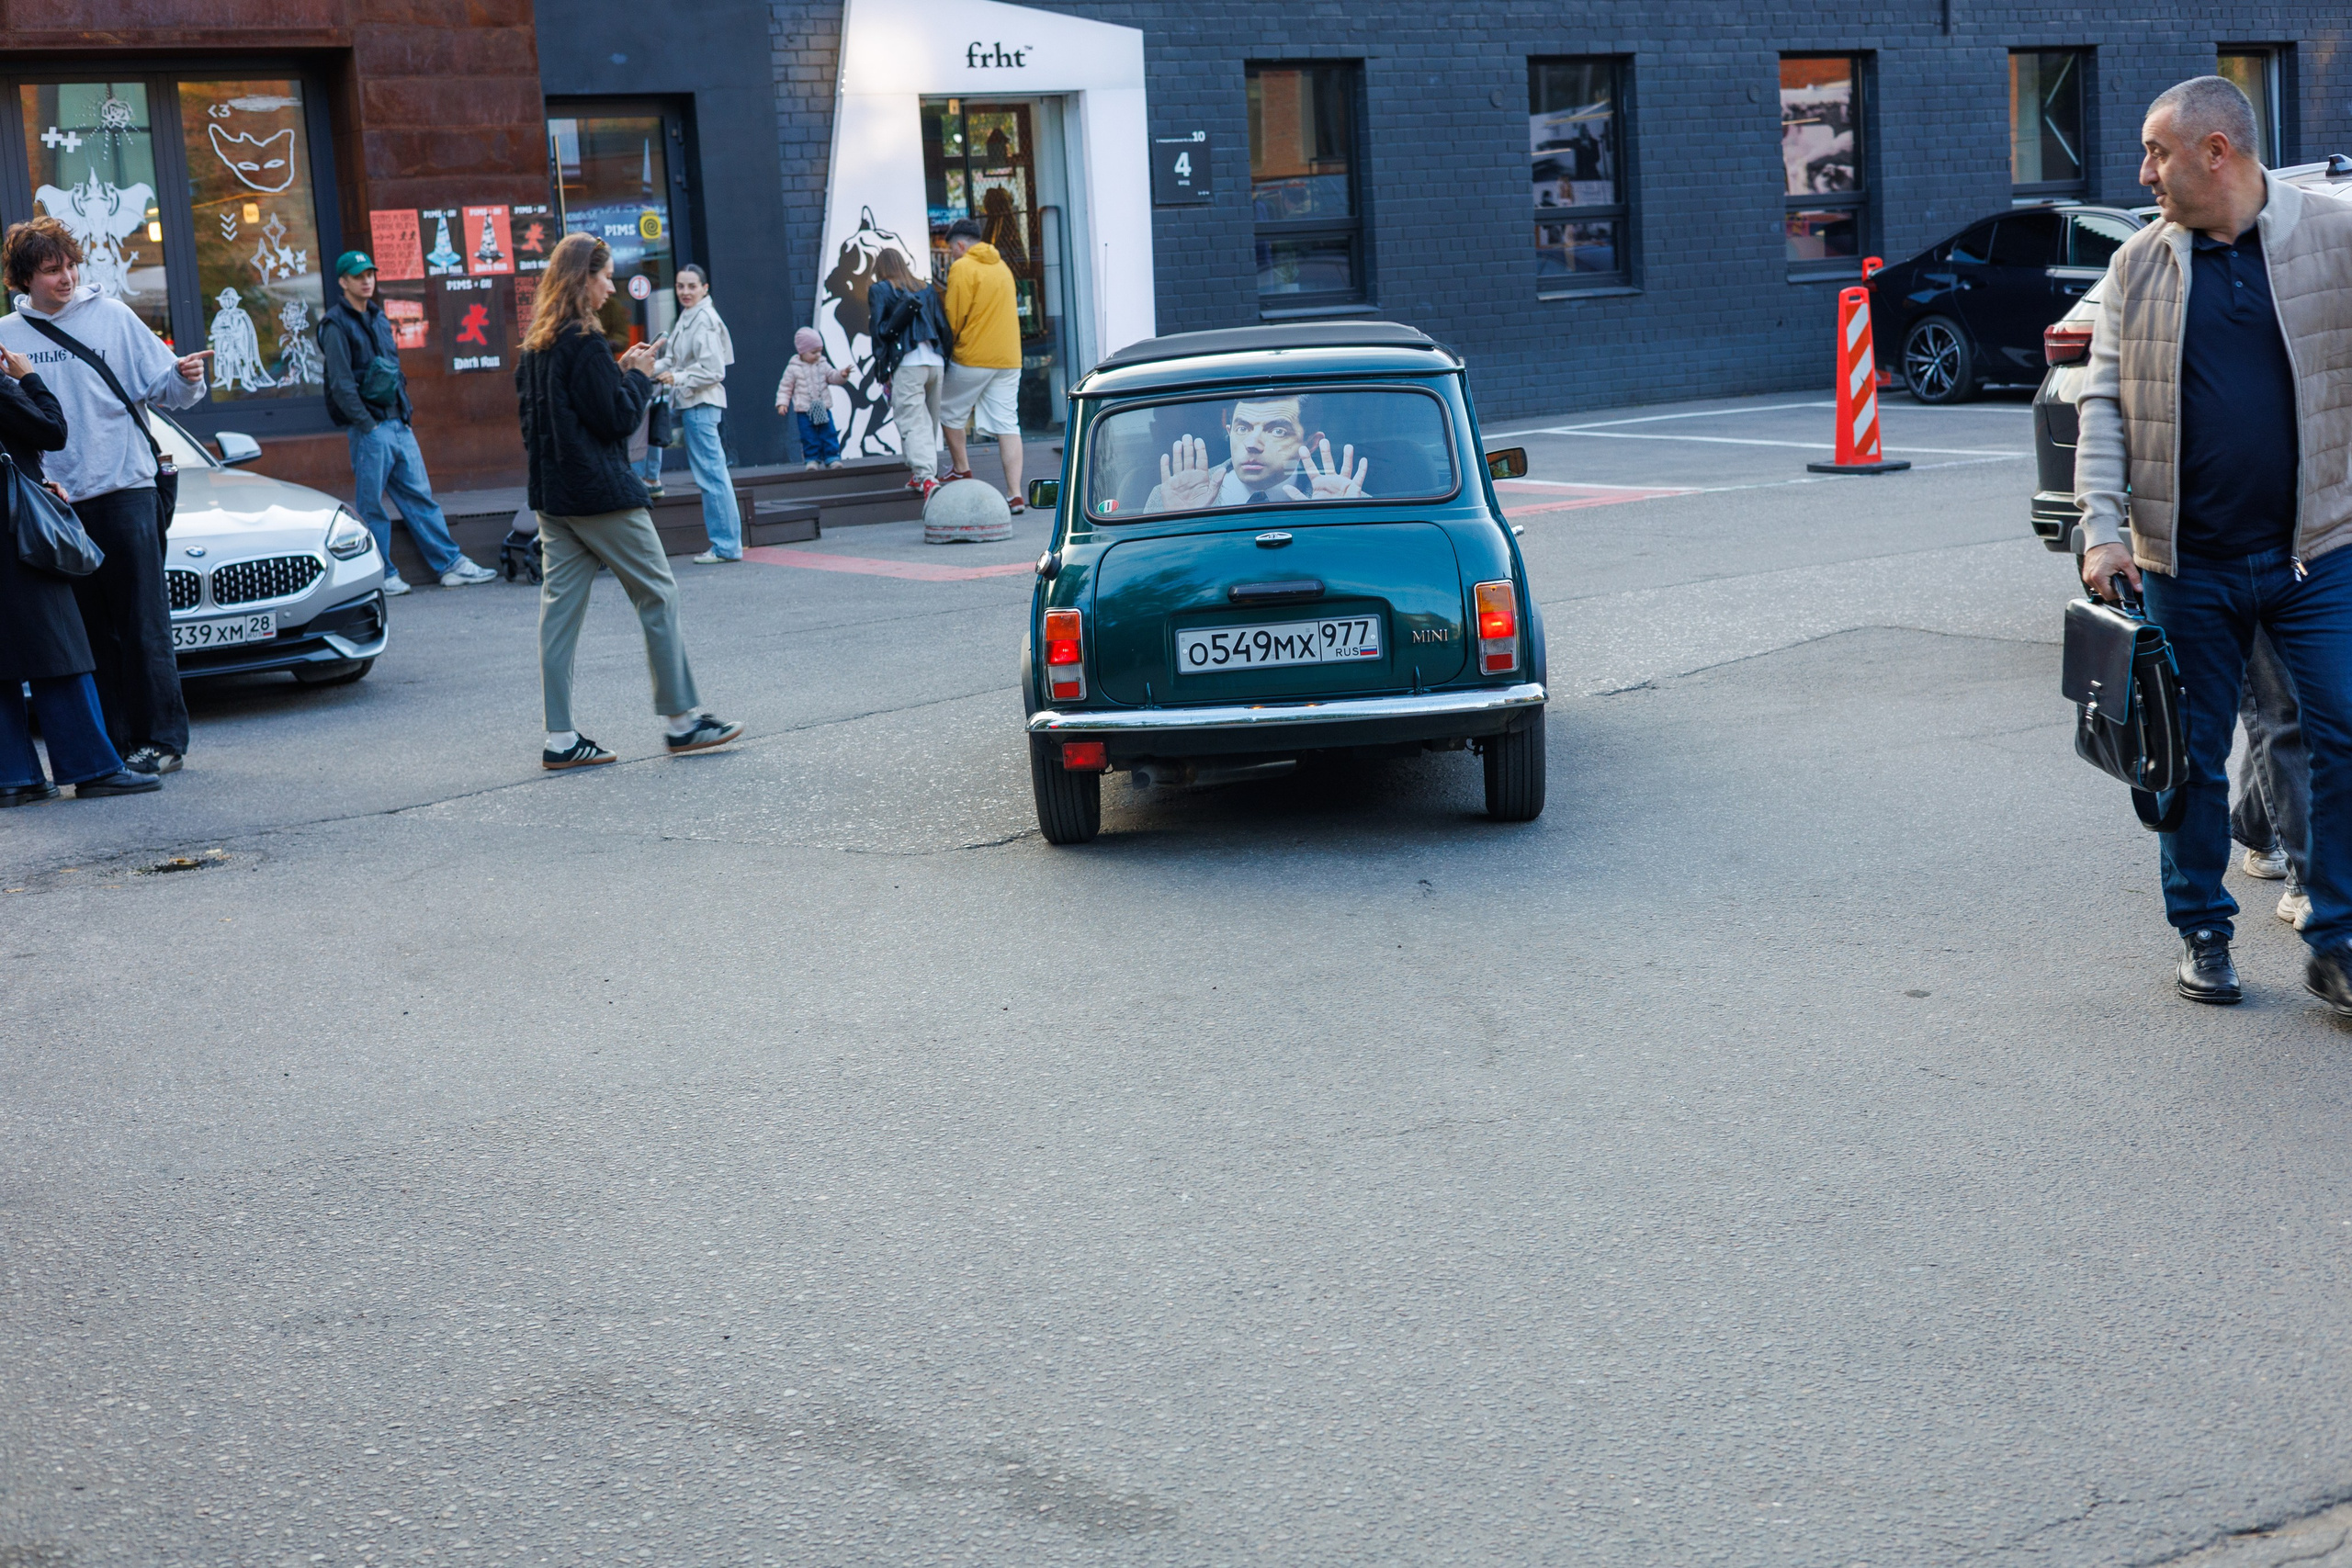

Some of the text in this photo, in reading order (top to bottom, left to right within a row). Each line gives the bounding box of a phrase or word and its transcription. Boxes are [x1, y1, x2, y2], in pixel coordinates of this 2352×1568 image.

[1192, 130, 1206, 142] 10
[1174, 152, 1192, 177] 4
[604, 223, 636, 237] PIMS
[446, 278, 473, 291] PIMS
[250, 615, 270, 633] 28
[1321, 620, 1369, 648] 977
[1411, 628, 1449, 644] MINI
[1335, 646, 1360, 657] RUS
